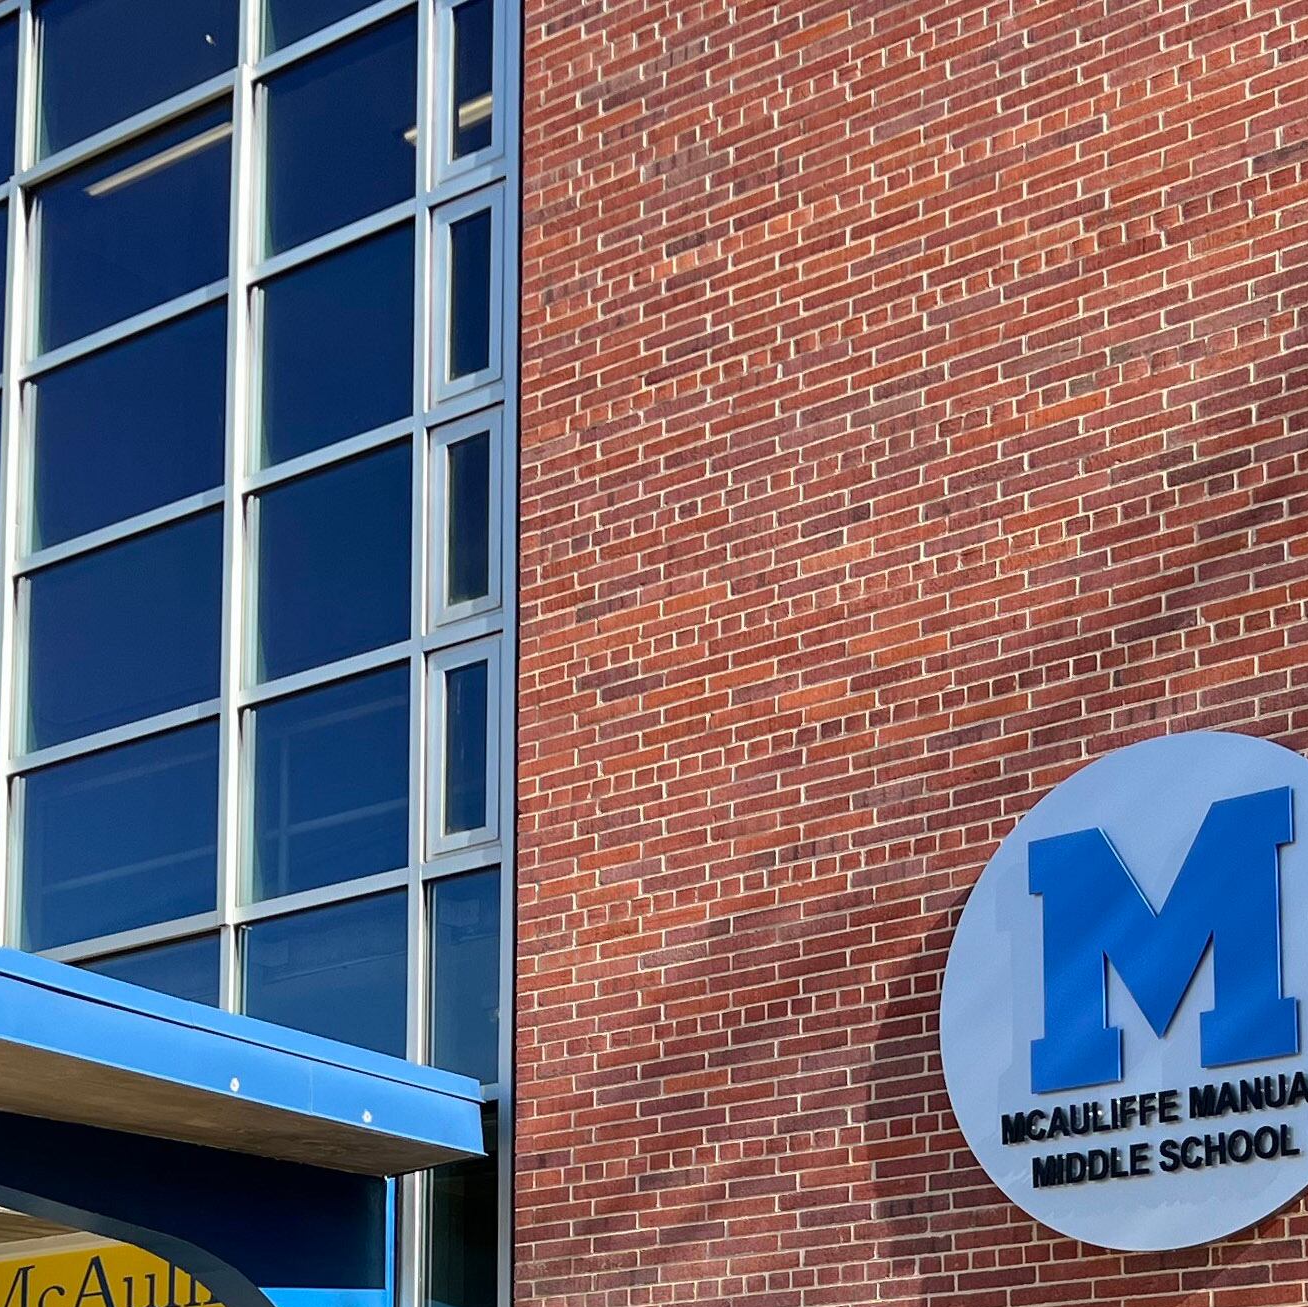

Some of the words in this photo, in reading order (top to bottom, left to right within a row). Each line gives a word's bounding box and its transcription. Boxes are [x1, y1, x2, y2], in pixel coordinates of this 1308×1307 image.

[1028, 785, 1300, 1094] M
[1001, 1089, 1181, 1145] MCAULIFFE
[1031, 1142, 1151, 1189] MIDDLE
[1158, 1124, 1301, 1172] SCHOOL
